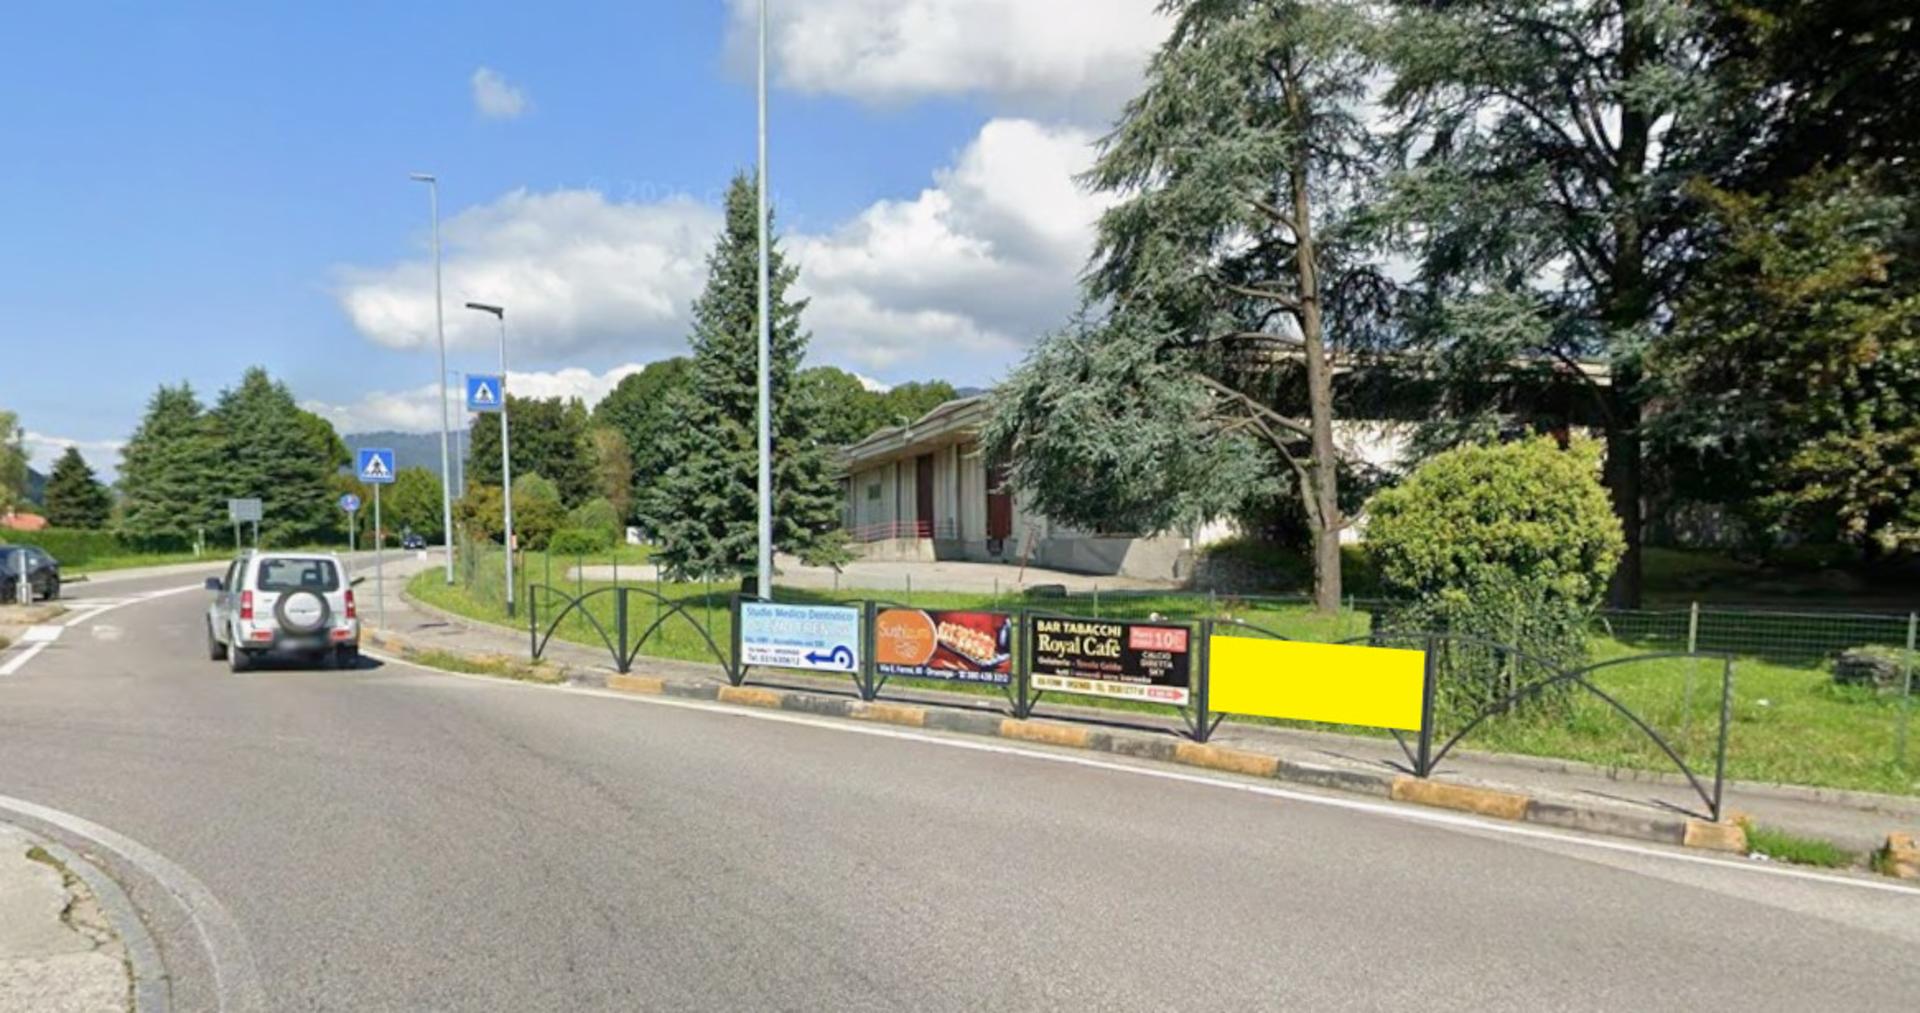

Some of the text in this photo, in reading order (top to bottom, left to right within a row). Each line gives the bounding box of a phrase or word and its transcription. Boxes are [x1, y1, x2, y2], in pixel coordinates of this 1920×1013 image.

[1037, 620, 1122, 637] BAR TABACCHI
[1038, 634, 1081, 658] Royal
